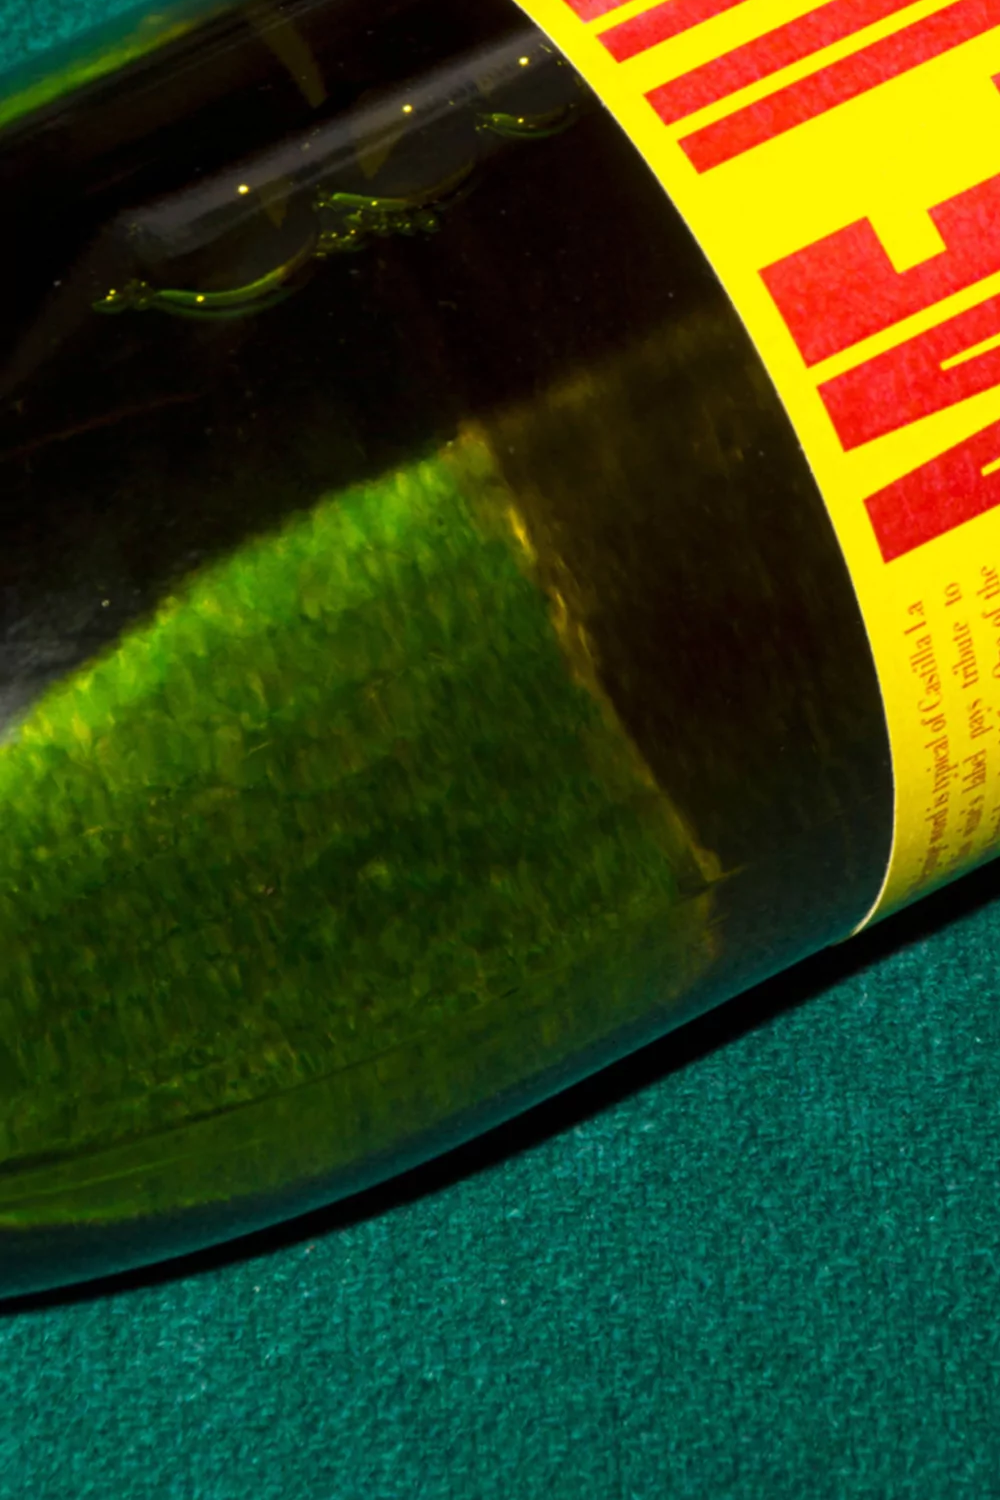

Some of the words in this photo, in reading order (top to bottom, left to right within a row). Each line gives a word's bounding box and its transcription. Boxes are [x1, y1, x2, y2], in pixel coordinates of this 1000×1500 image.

[943, 581, 963, 608] to
[903, 599, 928, 636] La
[908, 633, 943, 714] Castilla
[951, 621, 980, 690] tribute
[920, 712, 947, 733] of
[967, 697, 994, 740] pays
[924, 734, 960, 794] typical
